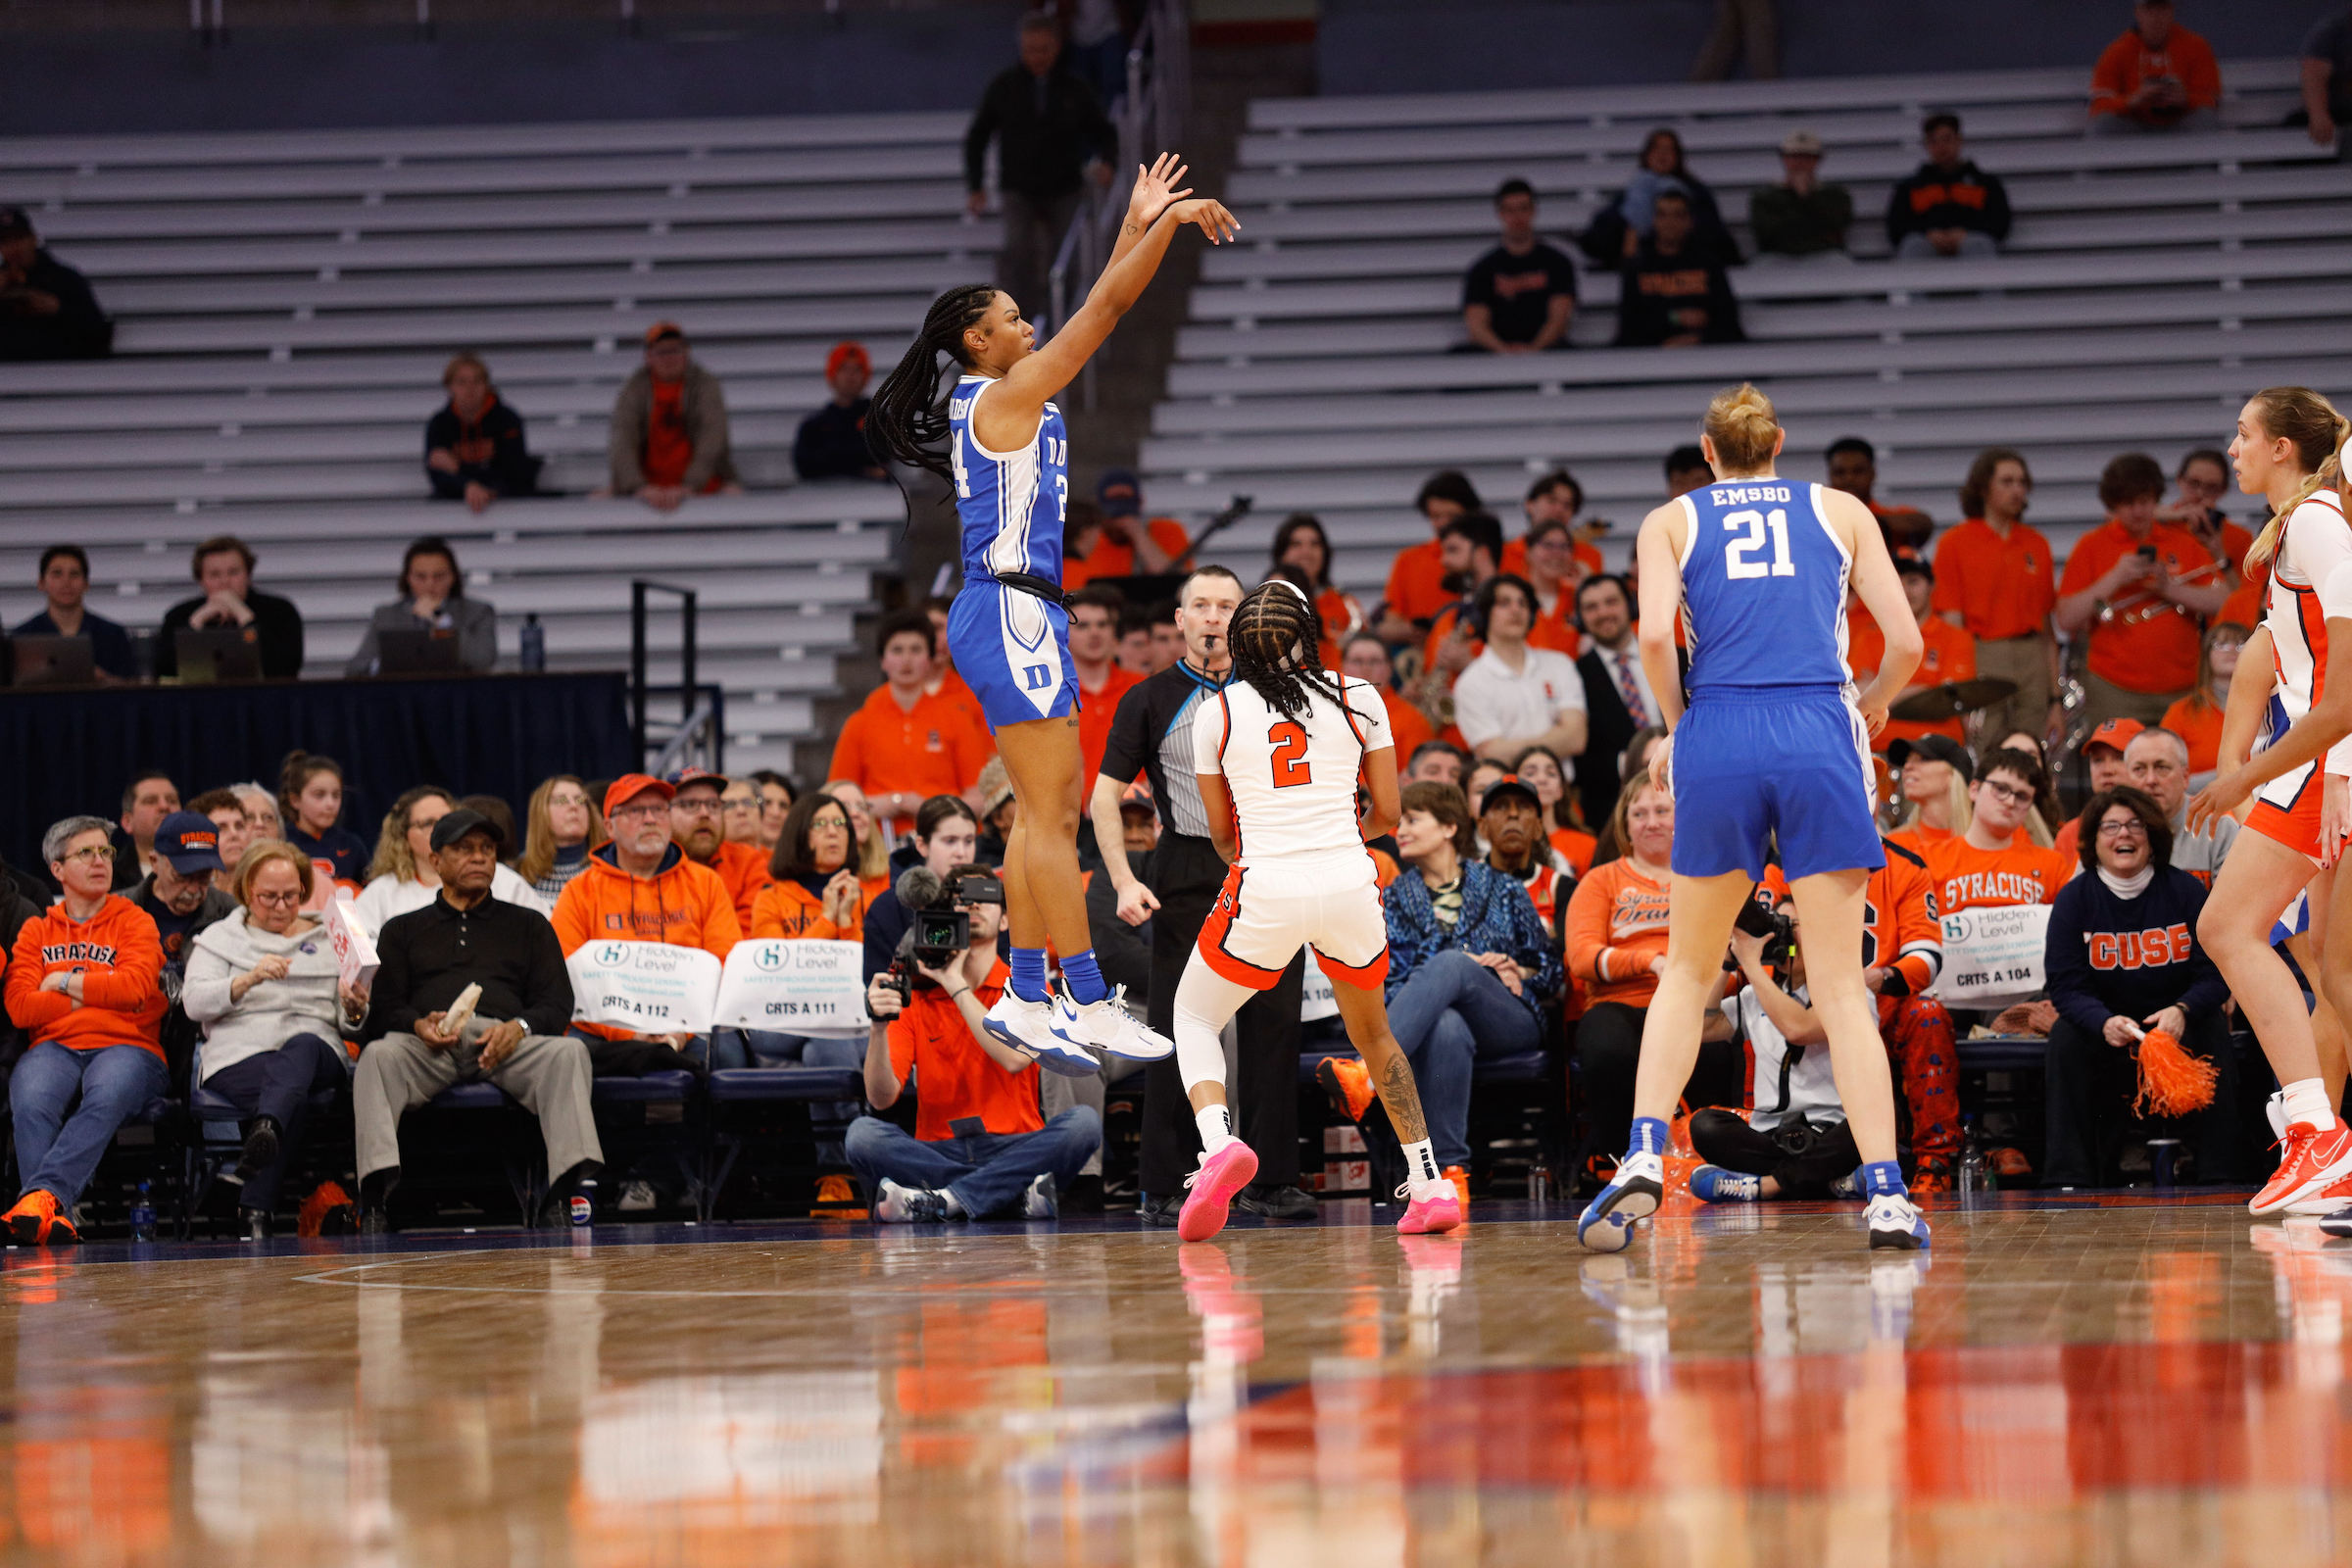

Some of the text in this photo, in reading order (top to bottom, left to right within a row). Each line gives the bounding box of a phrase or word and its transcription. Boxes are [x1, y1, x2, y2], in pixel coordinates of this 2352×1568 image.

[951, 428, 971, 499] 4
[1055, 473, 1068, 522] 2
[1710, 487, 1791, 507] EMSBO
[1723, 509, 1795, 580] 21
[1267, 720, 1312, 789] 2
[1945, 870, 2045, 909] SYRACUSE
[1978, 909, 2037, 923] Hidden
[1980, 921, 2023, 939] Level
[42, 942, 117, 967] YRACUSE
[637, 945, 694, 962] Hidden
[796, 944, 854, 956] Hidden
[2083, 922, 2191, 970] 'CUSE
[635, 956, 677, 972] Level
[796, 957, 839, 969] Level
[1956, 967, 2031, 987] CRTS A 104
[603, 995, 668, 1017] CRTS A 112
[765, 1003, 835, 1014] CRTS A 111
